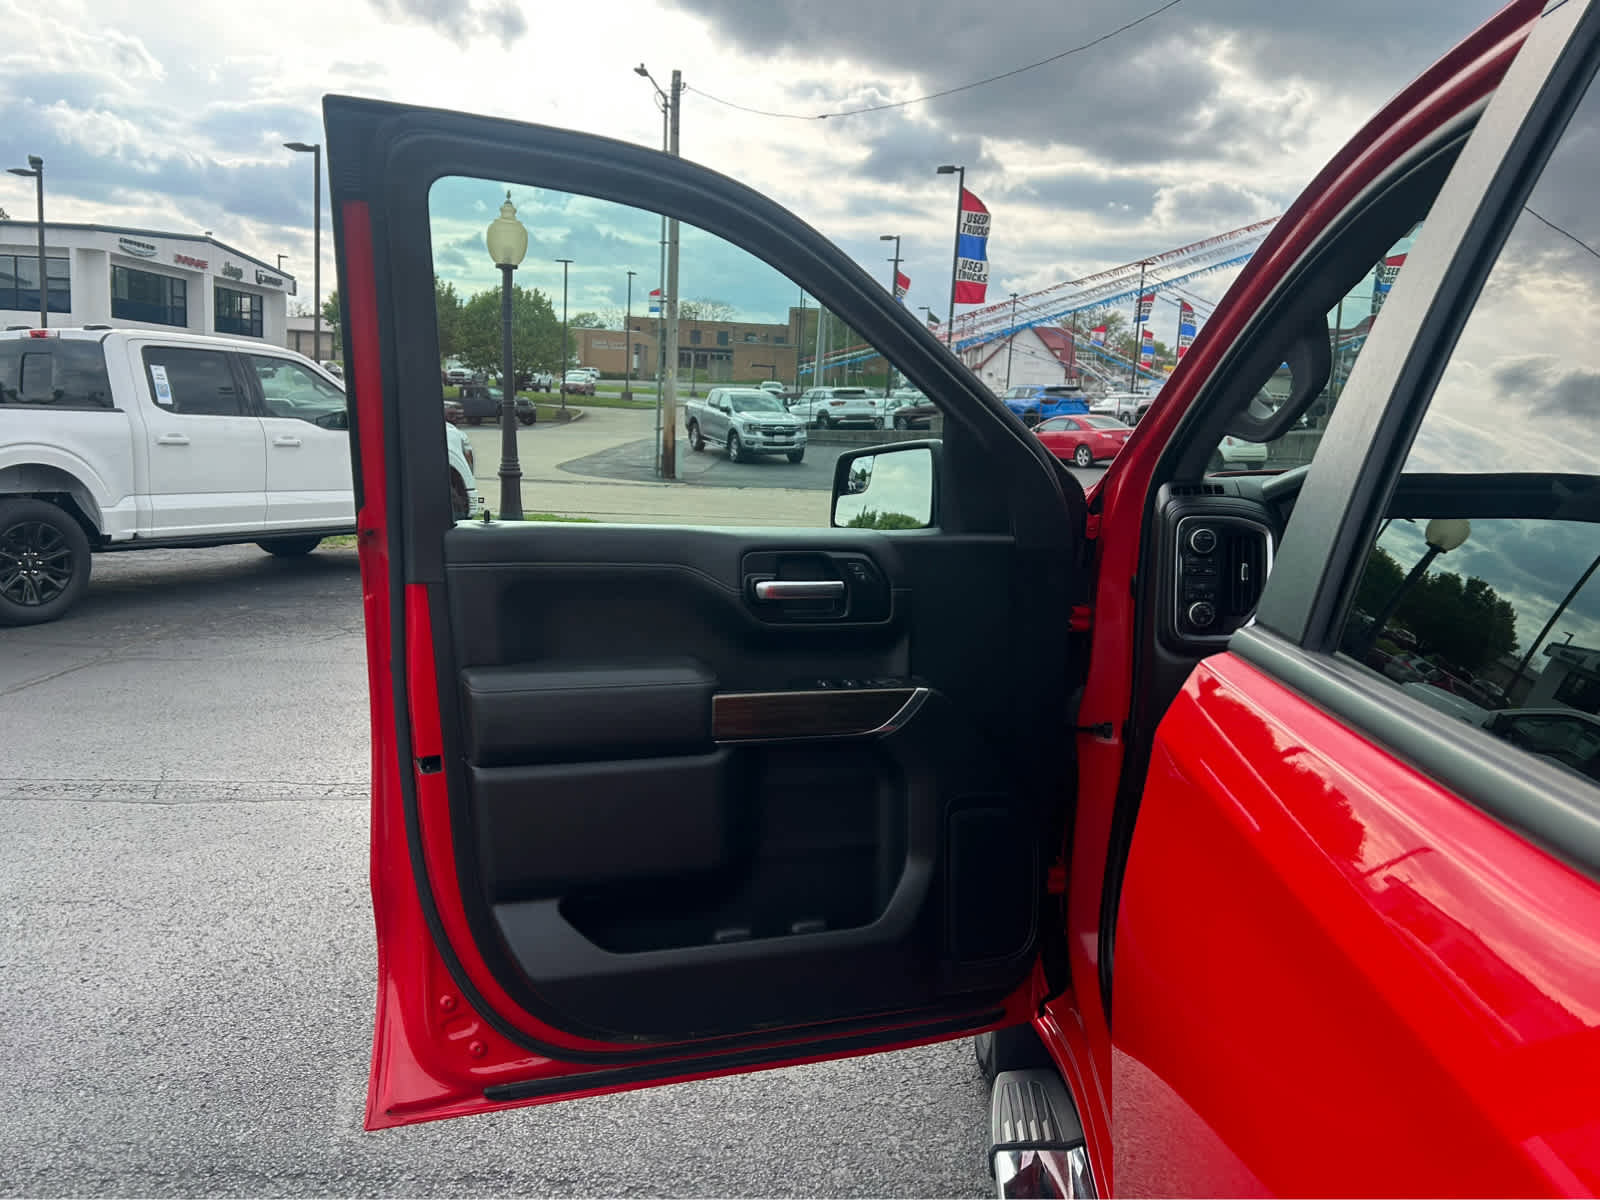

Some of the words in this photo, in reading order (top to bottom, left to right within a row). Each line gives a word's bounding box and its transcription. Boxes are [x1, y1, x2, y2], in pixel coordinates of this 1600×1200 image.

[966, 213, 989, 225] USED
[962, 222, 990, 236] TRUCKS
[961, 259, 983, 273] USED
[958, 269, 988, 283] TRUCKS
